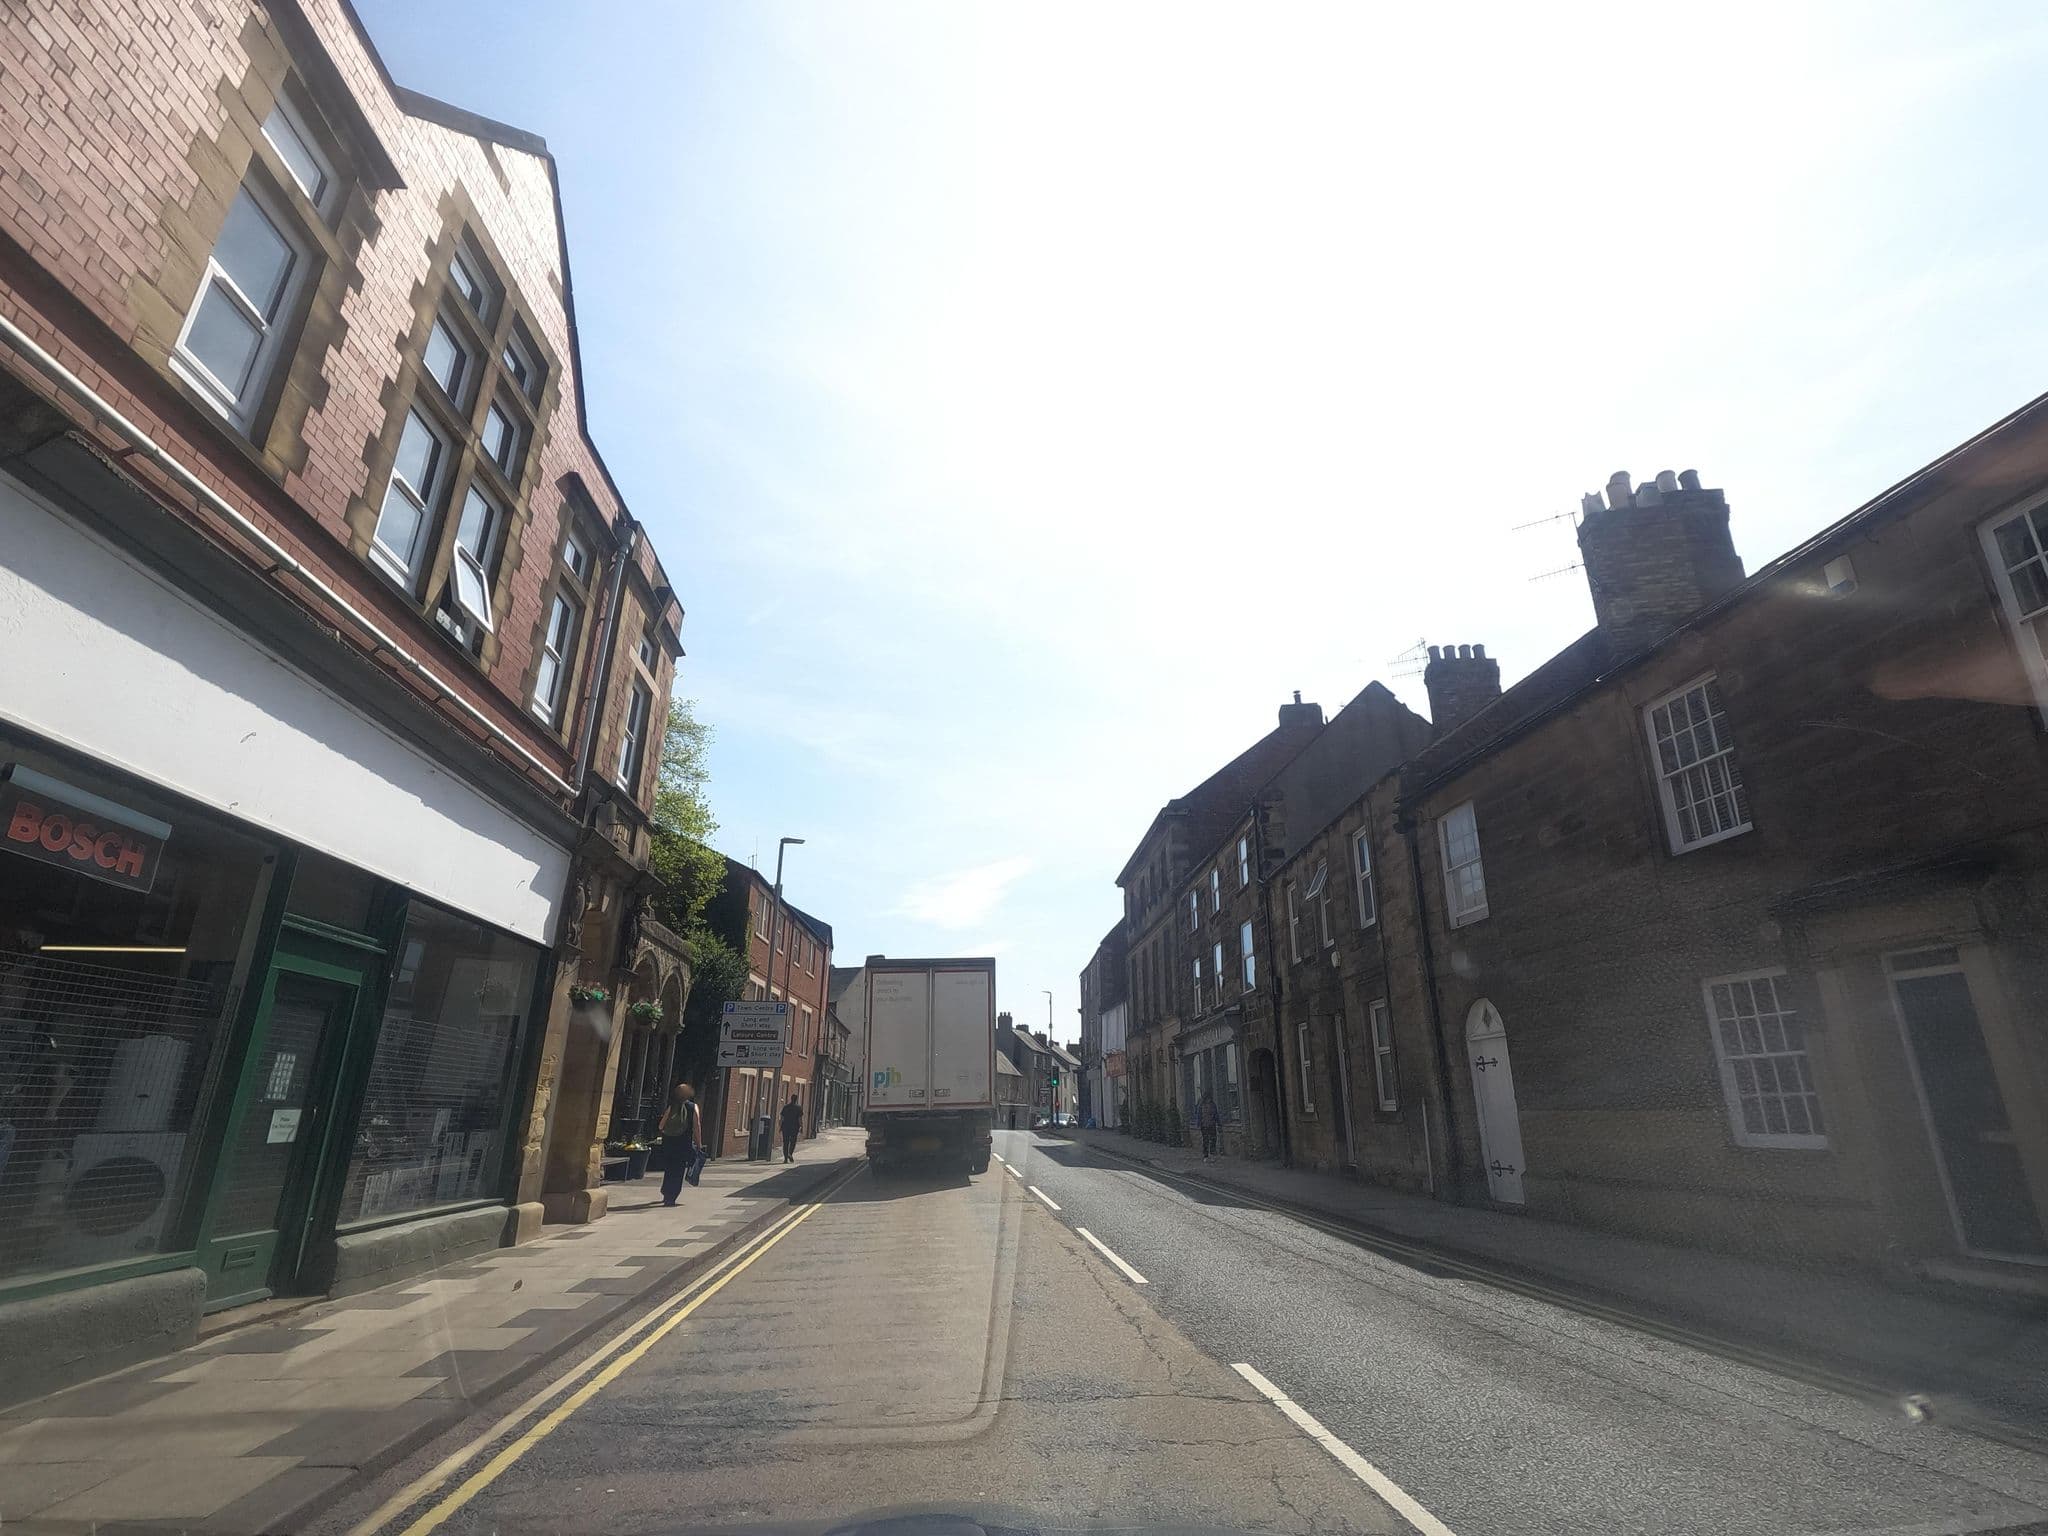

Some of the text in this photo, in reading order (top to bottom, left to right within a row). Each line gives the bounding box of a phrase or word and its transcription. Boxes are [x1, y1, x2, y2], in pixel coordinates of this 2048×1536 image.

[7, 801, 145, 878] BOSCH
[726, 1003, 735, 1012] P
[777, 1004, 785, 1013] P
[732, 1031, 777, 1039] Leisure Centre
[873, 1065, 902, 1088] pjh
